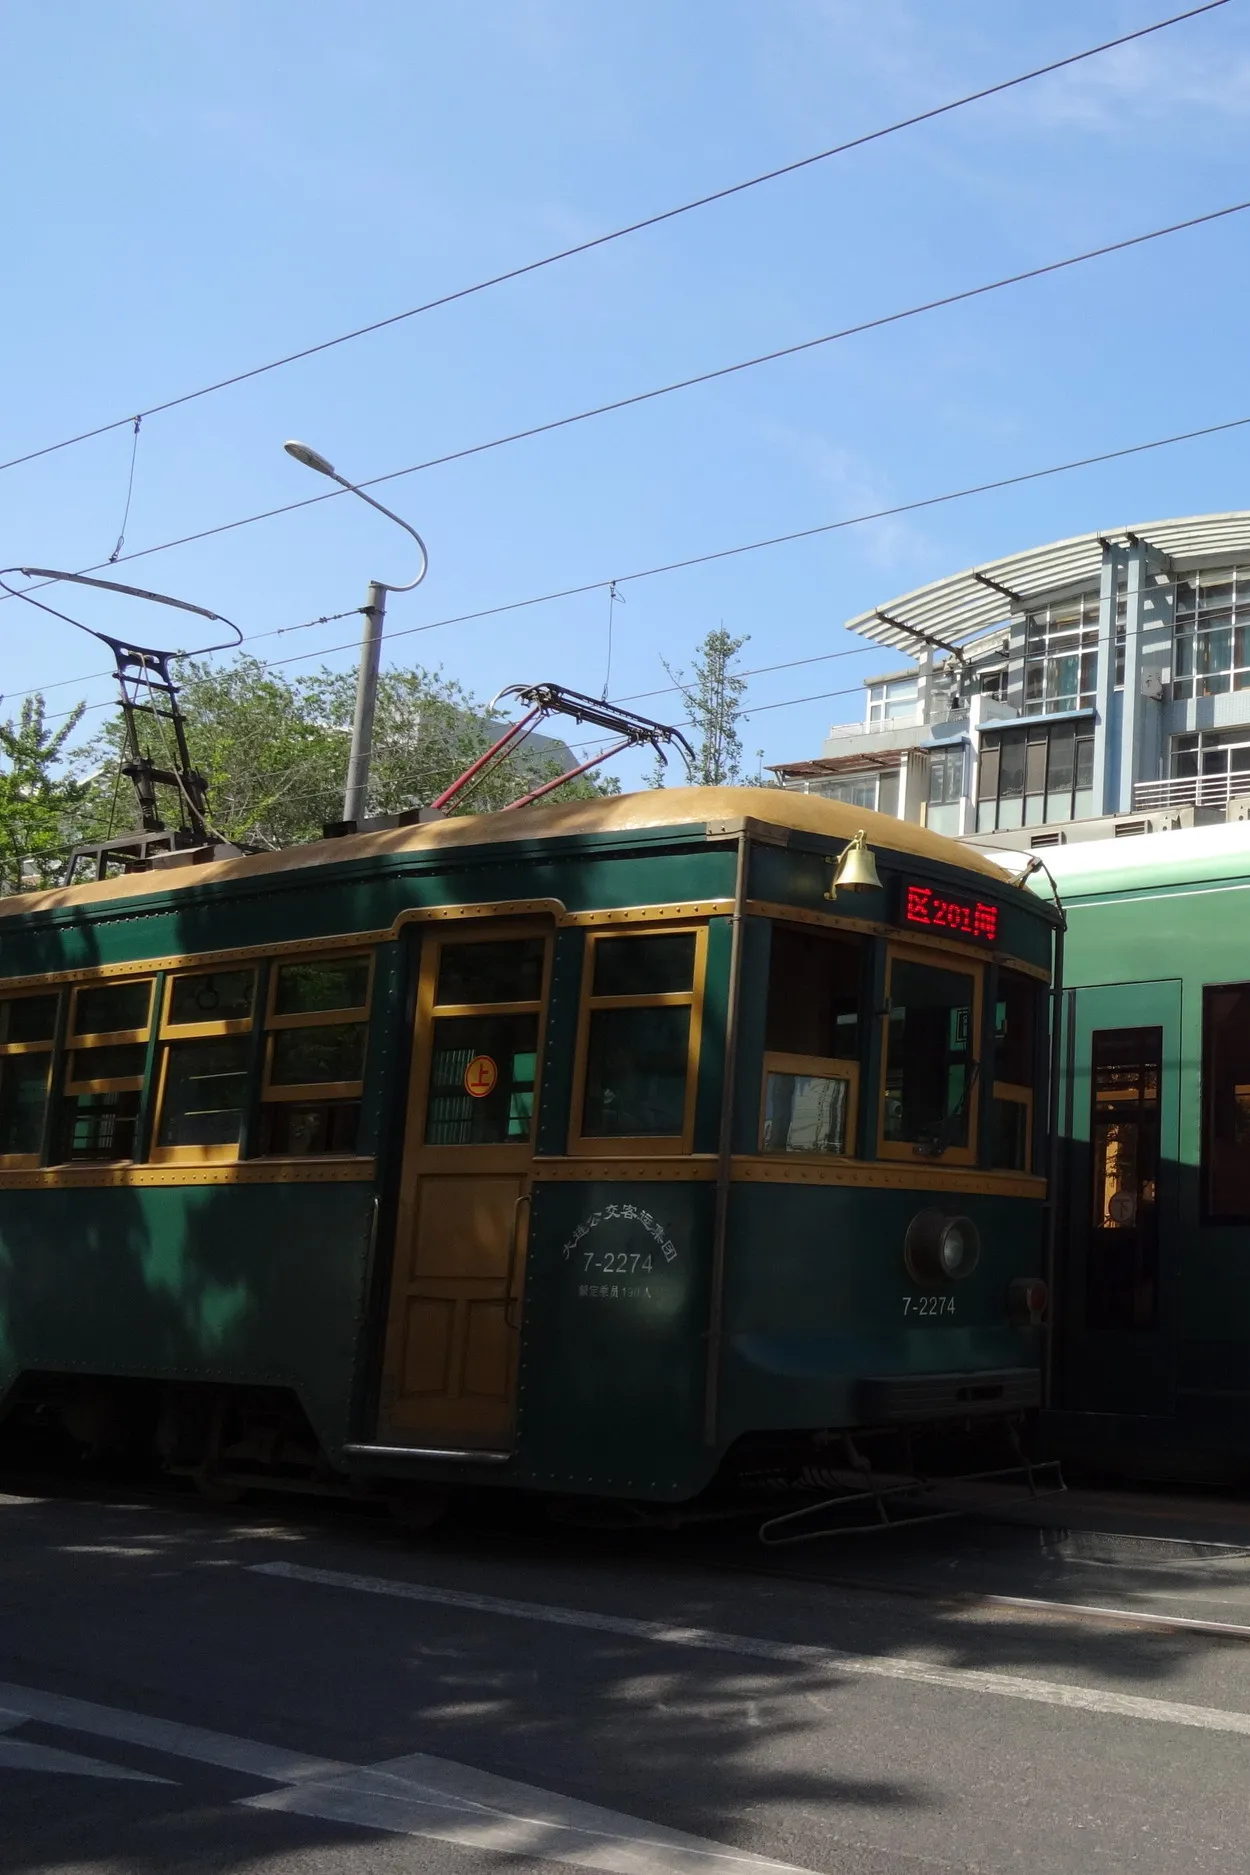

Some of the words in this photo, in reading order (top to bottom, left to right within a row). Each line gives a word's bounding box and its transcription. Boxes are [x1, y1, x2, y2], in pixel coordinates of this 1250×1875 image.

[470, 1063, 490, 1087] 上
[1115, 1198, 1130, 1218] 下
[563, 1204, 678, 1263] 大连公交客运集团
[583, 1252, 653, 1274] 7-2274
[902, 1296, 956, 1316] 7-2274
